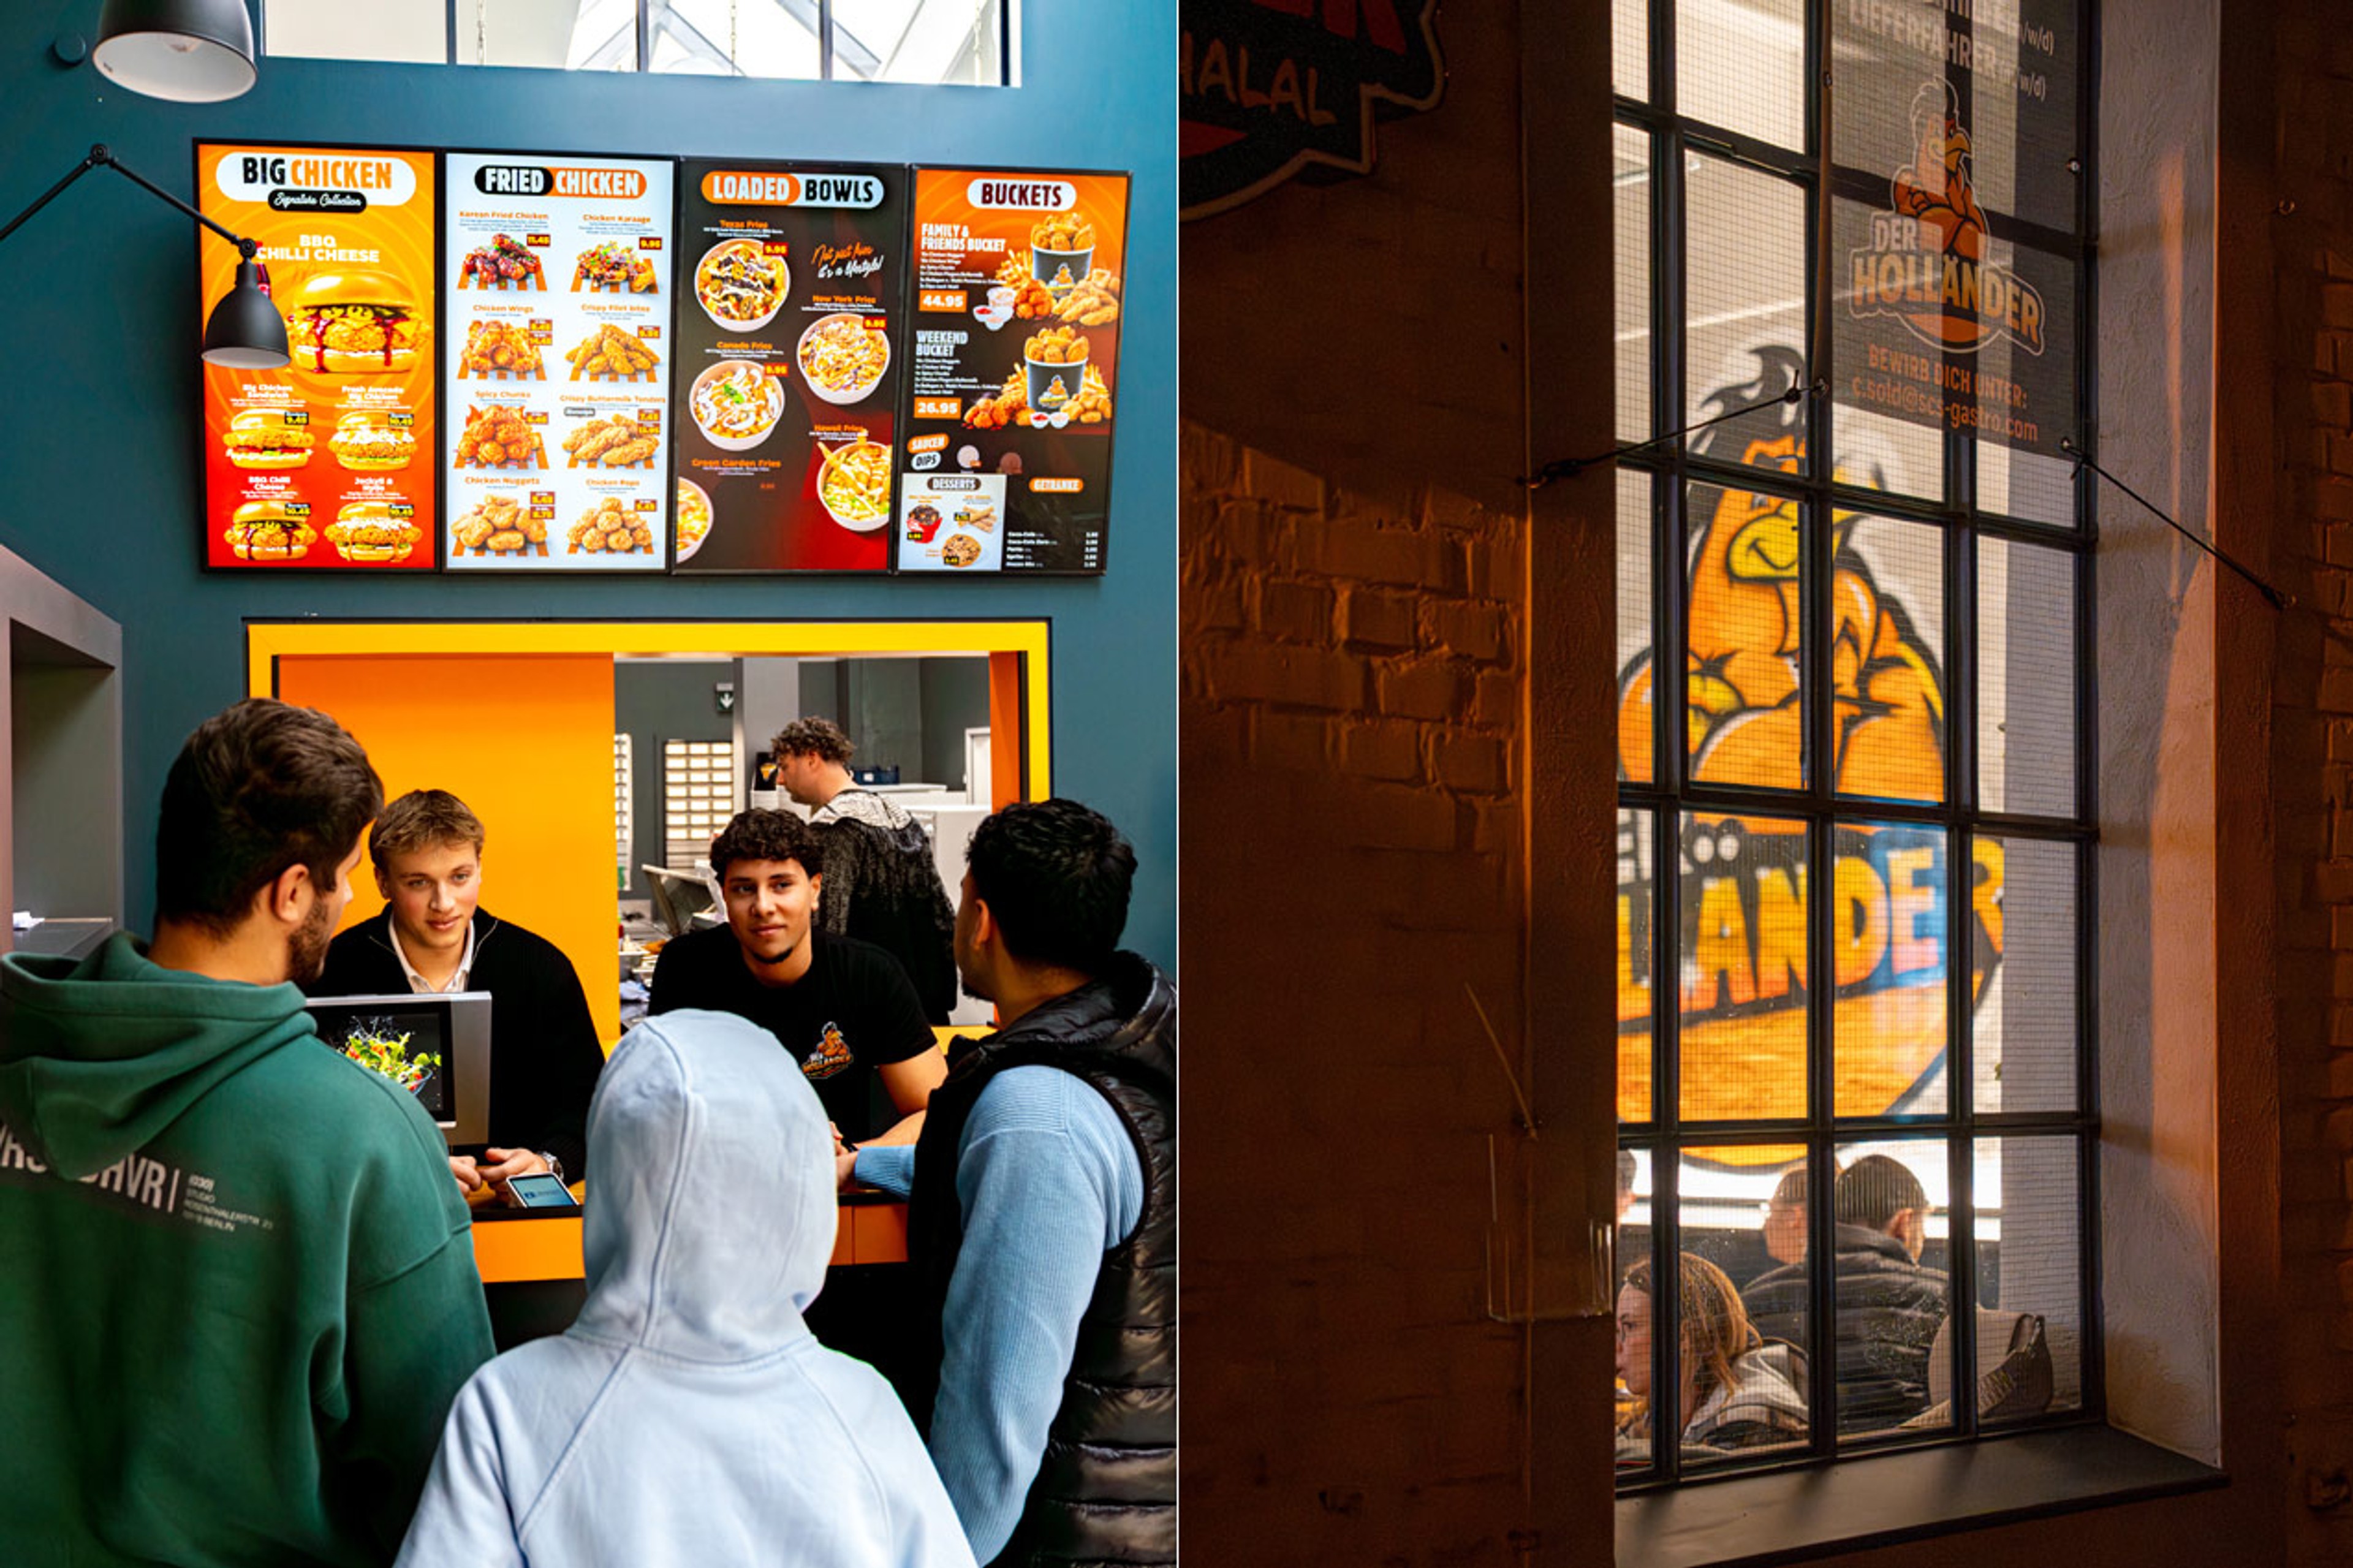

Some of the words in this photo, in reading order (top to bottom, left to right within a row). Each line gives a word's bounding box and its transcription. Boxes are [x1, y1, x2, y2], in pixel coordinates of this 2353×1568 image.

[243, 157, 285, 185] BIG
[290, 160, 392, 189] CHICKEN
[485, 168, 544, 193] FRIED
[555, 170, 639, 197] CHICKEN
[713, 175, 790, 201] LOADED
[805, 180, 873, 203] BOWLS
[981, 183, 1062, 207] BUCKETS
[719, 219, 745, 228] Texas
[921, 223, 961, 237] FAMILY
[299, 235, 336, 248] BBQ
[1873, 218, 1918, 252] DER
[765, 245, 786, 254] 9.95
[921, 237, 966, 251] FRIENDS
[968, 238, 1006, 252] BUCKET
[256, 248, 310, 261] CHILLI
[313, 249, 380, 263] CHEESE
[922, 295, 963, 307] 44.95
[1853, 254, 2042, 344] HOLLÄNDER
[508, 305, 534, 314] Wings
[581, 304, 606, 312] Crispy
[915, 330, 969, 344] WEEKEND
[915, 344, 955, 357] BUCKET
[1869, 343, 1930, 385] BEWIRB
[1933, 359, 1971, 394] DICH
[1974, 373, 2028, 410] UNTER:
[475, 391, 498, 400] Spicy
[917, 403, 957, 415] 26.95
[911, 436, 945, 450] SAUCEN
[916, 455, 937, 467] DIPS
[502, 477, 539, 486] Nuggets
[932, 477, 976, 490] DESSERTS
